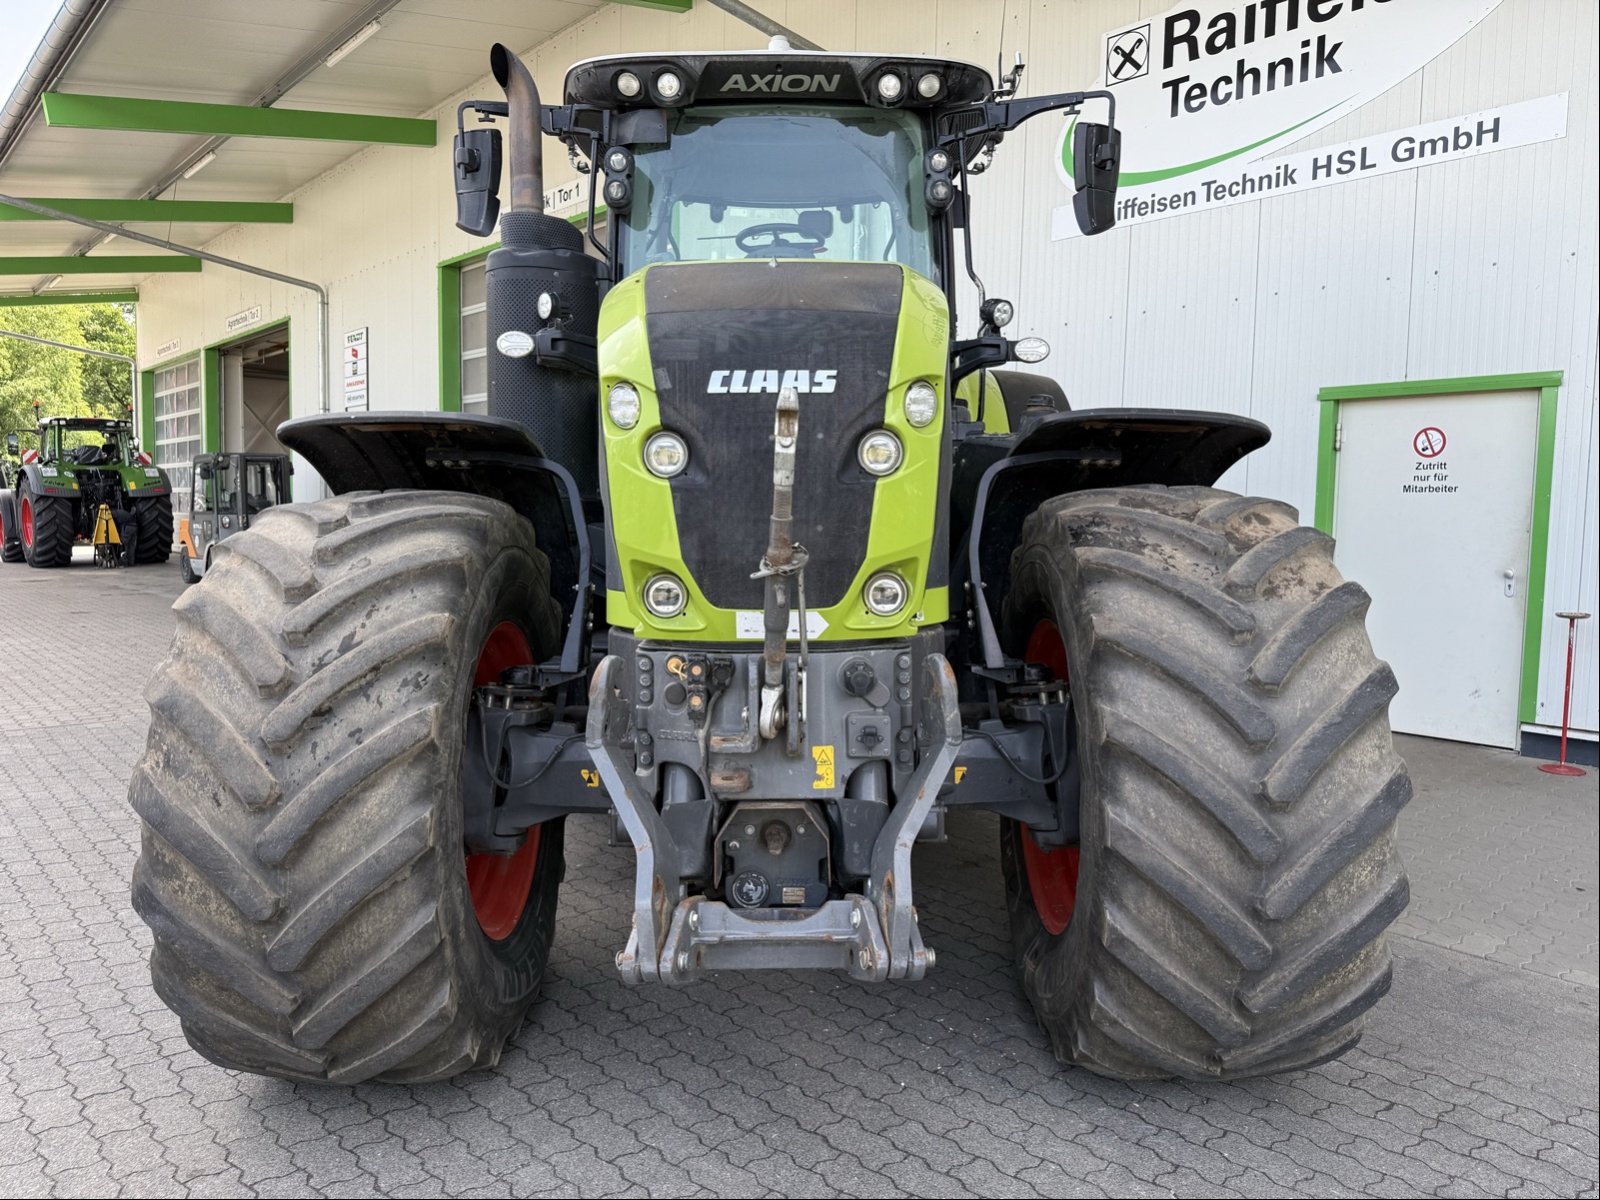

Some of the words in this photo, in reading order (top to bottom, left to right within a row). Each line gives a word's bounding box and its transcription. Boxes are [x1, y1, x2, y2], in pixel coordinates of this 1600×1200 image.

[1163, 0, 1395, 69] Raiffe
[719, 73, 841, 92] AXION
[1162, 34, 1344, 118] Technik
[1117, 190, 1196, 221] iffeisen
[1201, 163, 1298, 203] Technik
[1311, 149, 1378, 181] HSL
[1390, 116, 1501, 163] GmbH
[558, 188, 573, 203] Tor
[575, 182, 580, 197] 1
[707, 369, 838, 394] CLAAS
[1415, 461, 1447, 471] Zutritt
[1413, 474, 1431, 482] nur
[1433, 472, 1448, 482] für
[1402, 484, 1459, 493] Mitarbeiter
